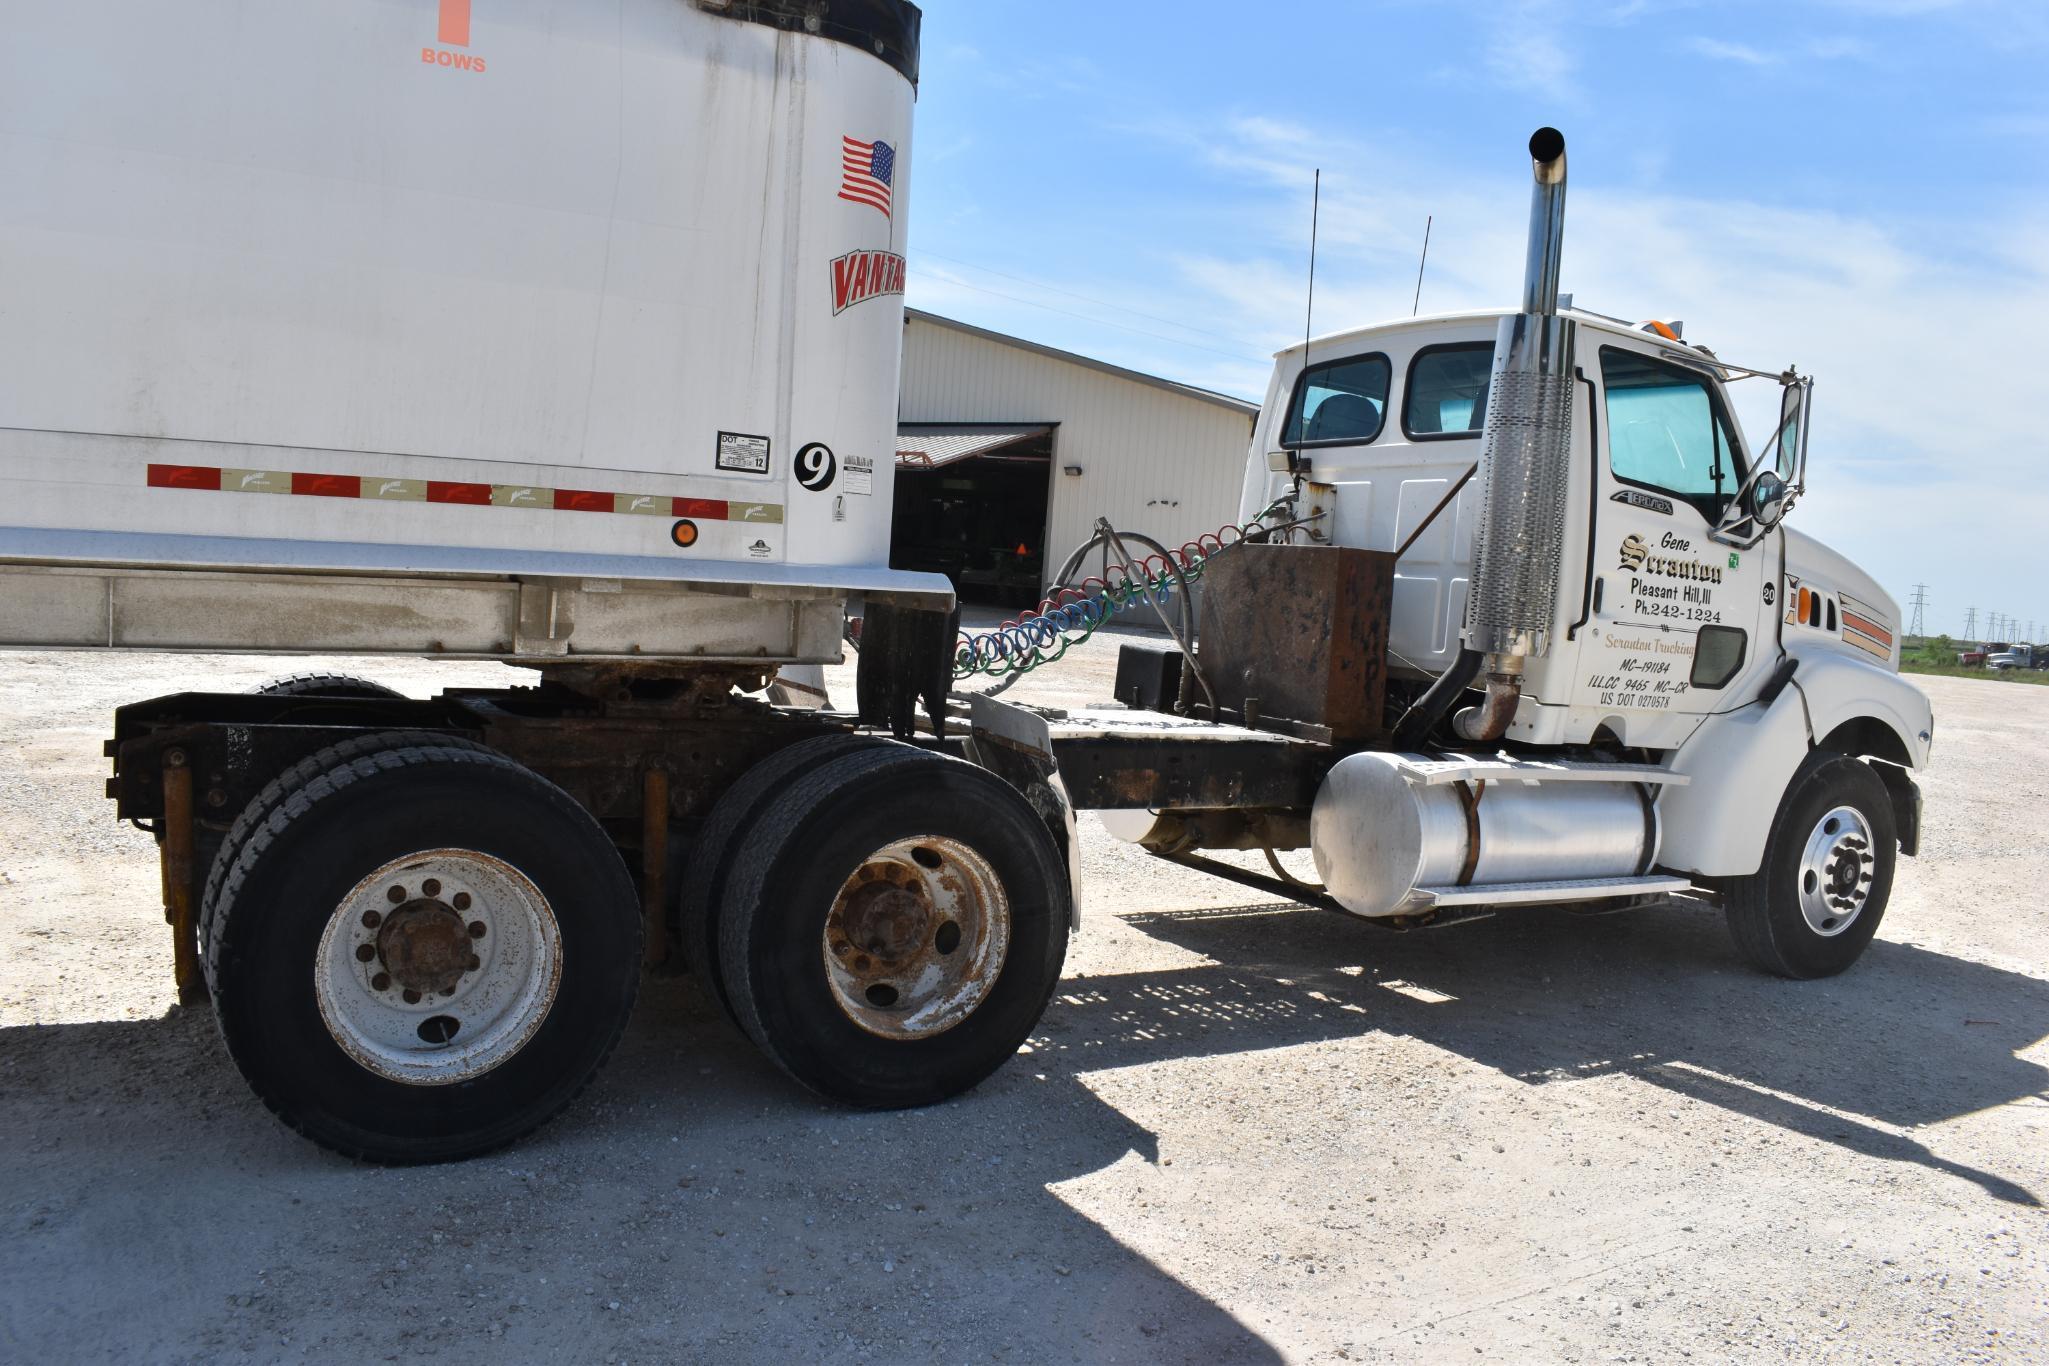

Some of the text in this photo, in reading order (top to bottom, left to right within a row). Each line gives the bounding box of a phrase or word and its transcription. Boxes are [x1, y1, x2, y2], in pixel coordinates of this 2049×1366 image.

[421, 47, 486, 73] BOWS
[721, 435, 737, 443] DOT
[755, 458, 764, 467] 12
[802, 446, 830, 486] 9
[1661, 531, 1690, 551] Gene
[1617, 533, 1723, 585] Scranton
[1631, 577, 1678, 600] Pleasant
[1763, 587, 1775, 601] 20
[1634, 599, 1721, 623] Ph.242-1224
[1605, 634, 1696, 659] Scranton Trucking
[1619, 658, 1671, 674] MC-191184
[1623, 679, 1650, 691] 9465
[1653, 681, 1689, 694] MC-CR
[1600, 692, 1614, 705] US
[1617, 693, 1635, 706] DOT
